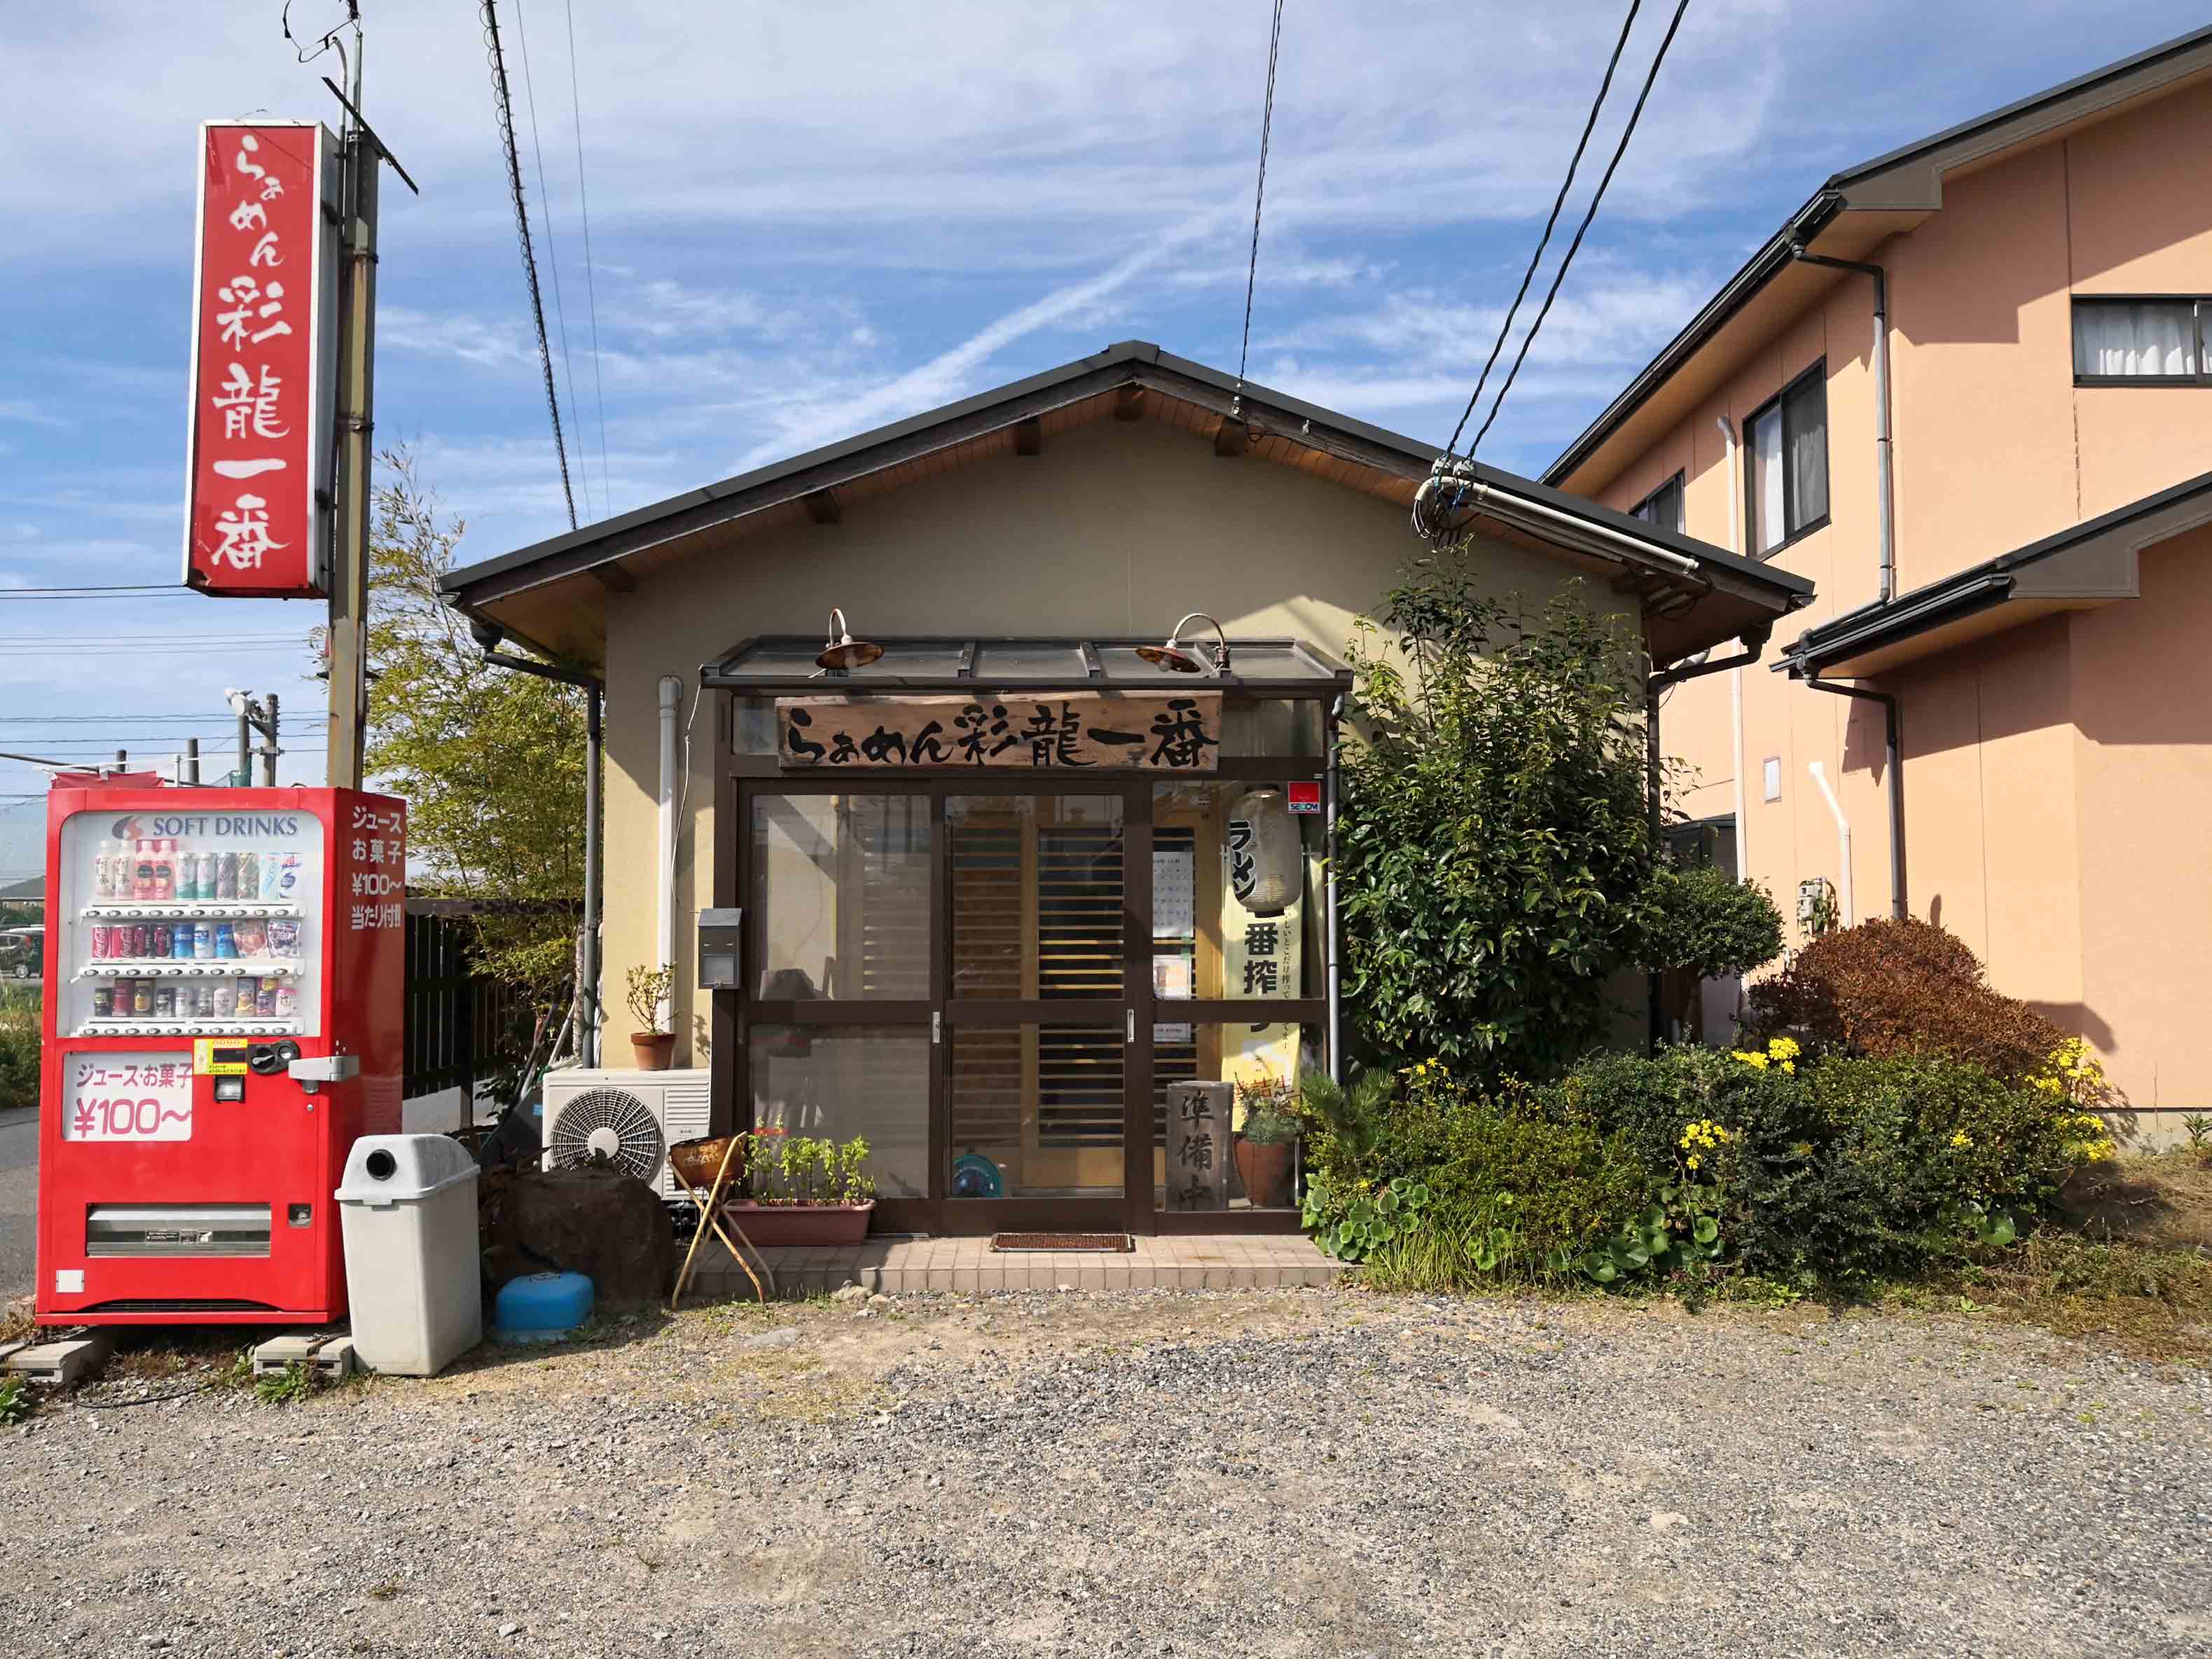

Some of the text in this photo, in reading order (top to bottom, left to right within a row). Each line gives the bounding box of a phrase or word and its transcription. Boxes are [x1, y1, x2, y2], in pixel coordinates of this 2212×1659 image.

[153, 817, 298, 836] SOFT DRINKS
[352, 805, 402, 835] ジュース
[352, 838, 402, 865] お菓子
[1229, 819, 1256, 902] ラーメン
[1177, 1089, 1215, 1211] 準備中
